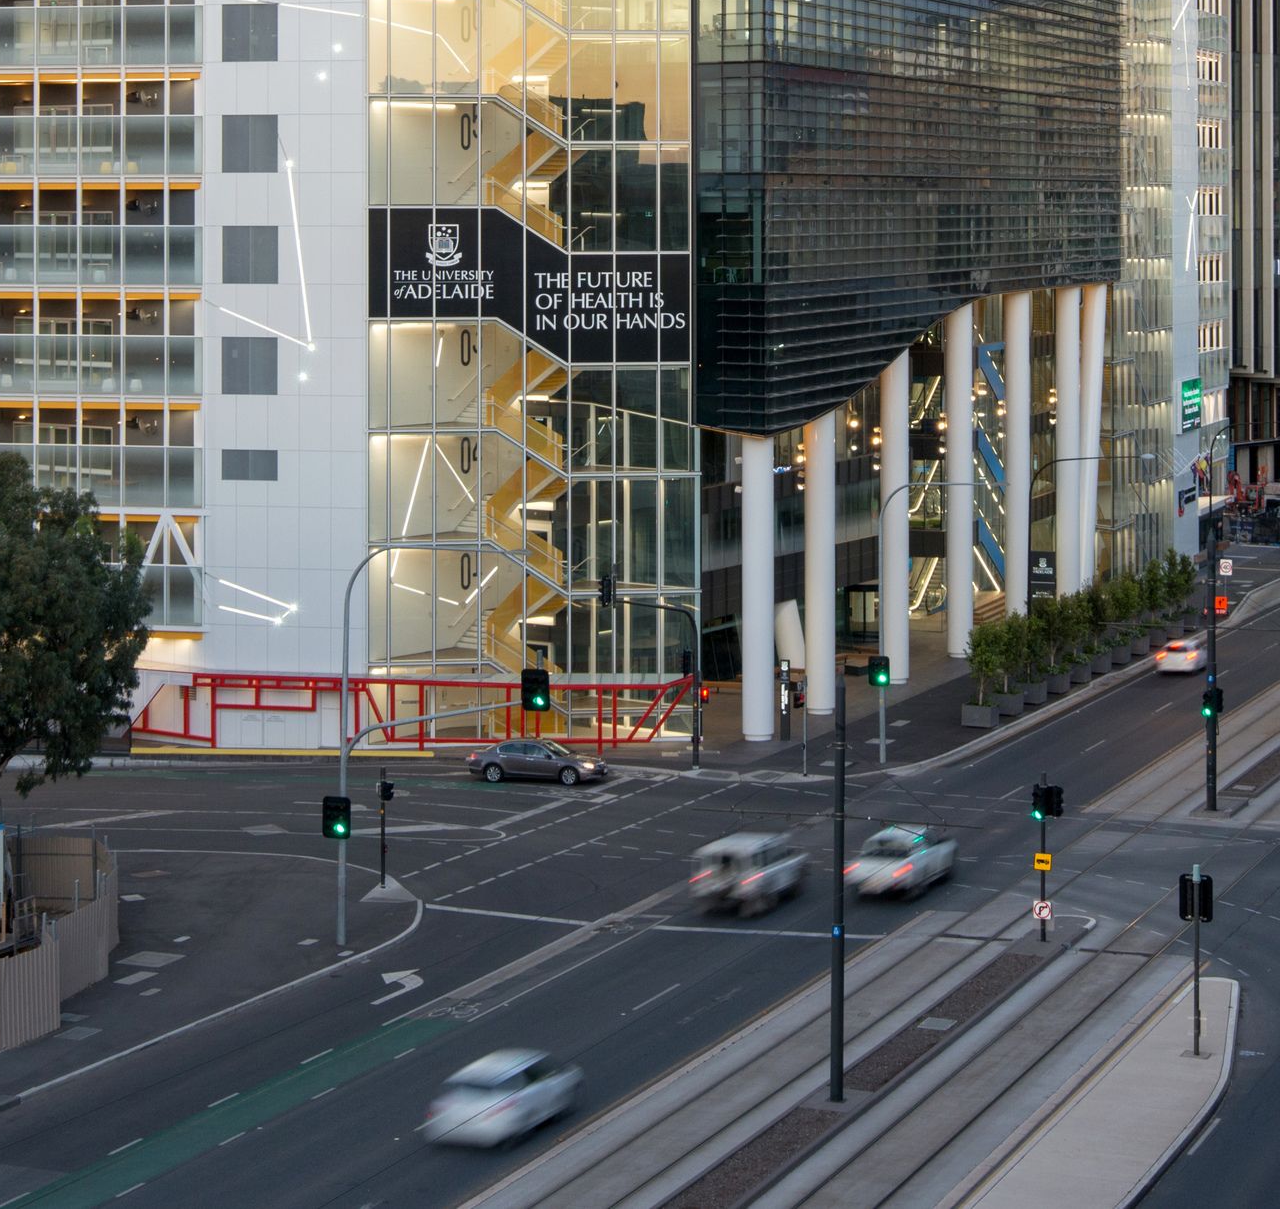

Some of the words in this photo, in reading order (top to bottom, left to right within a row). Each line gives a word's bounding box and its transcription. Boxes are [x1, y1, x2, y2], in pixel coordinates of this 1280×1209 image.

[393, 270, 418, 281] THE
[421, 270, 494, 281] UNIVERSITY
[534, 272, 570, 289] THE
[577, 271, 653, 288] FUTURE
[394, 285, 407, 299] of
[404, 284, 494, 299] ADELAIDE
[535, 293, 563, 310] OF
[571, 292, 643, 309] HEALTH
[649, 292, 665, 309] IS
[536, 314, 557, 331] IN
[563, 313, 609, 331] OUR
[616, 312, 686, 330] HANDS
